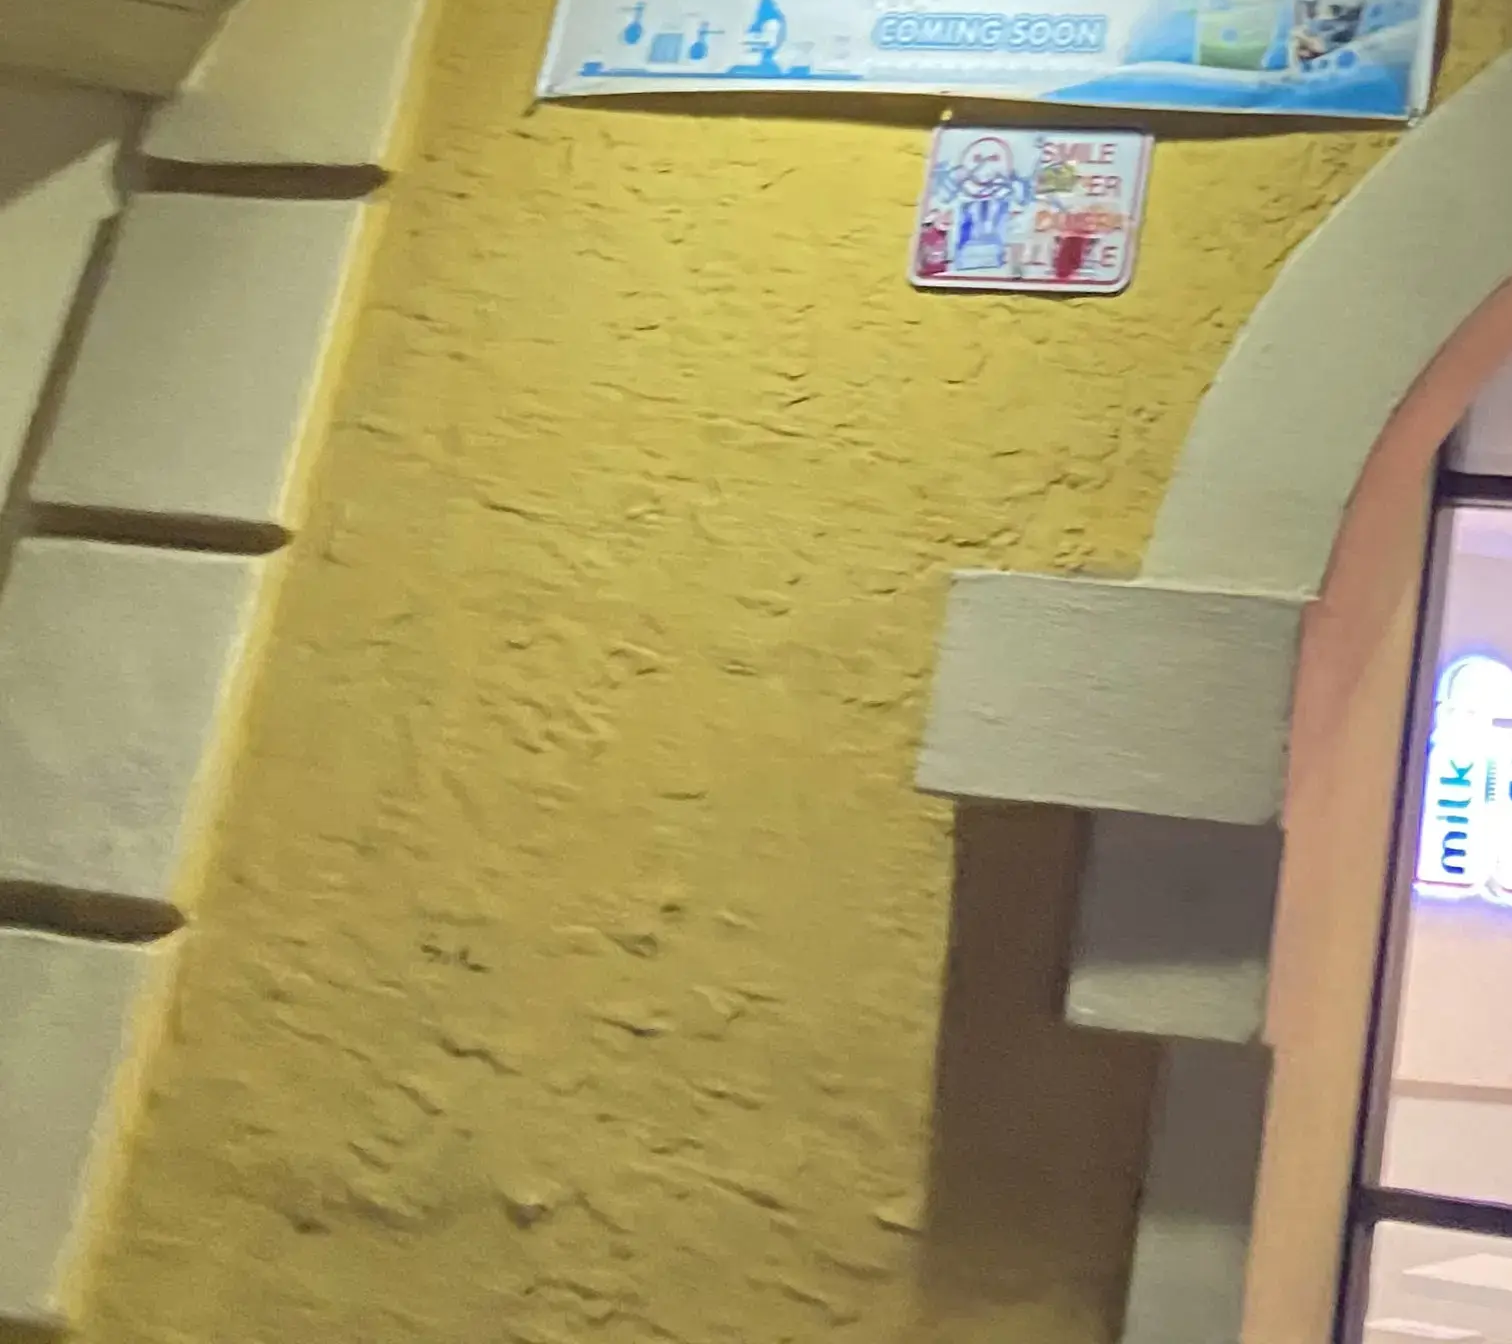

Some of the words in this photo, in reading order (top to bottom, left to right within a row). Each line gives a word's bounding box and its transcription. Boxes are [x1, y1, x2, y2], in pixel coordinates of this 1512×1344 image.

[880, 16, 1001, 49] COMING
[1010, 18, 1103, 51] SOON
[1436, 759, 1474, 874] milk
